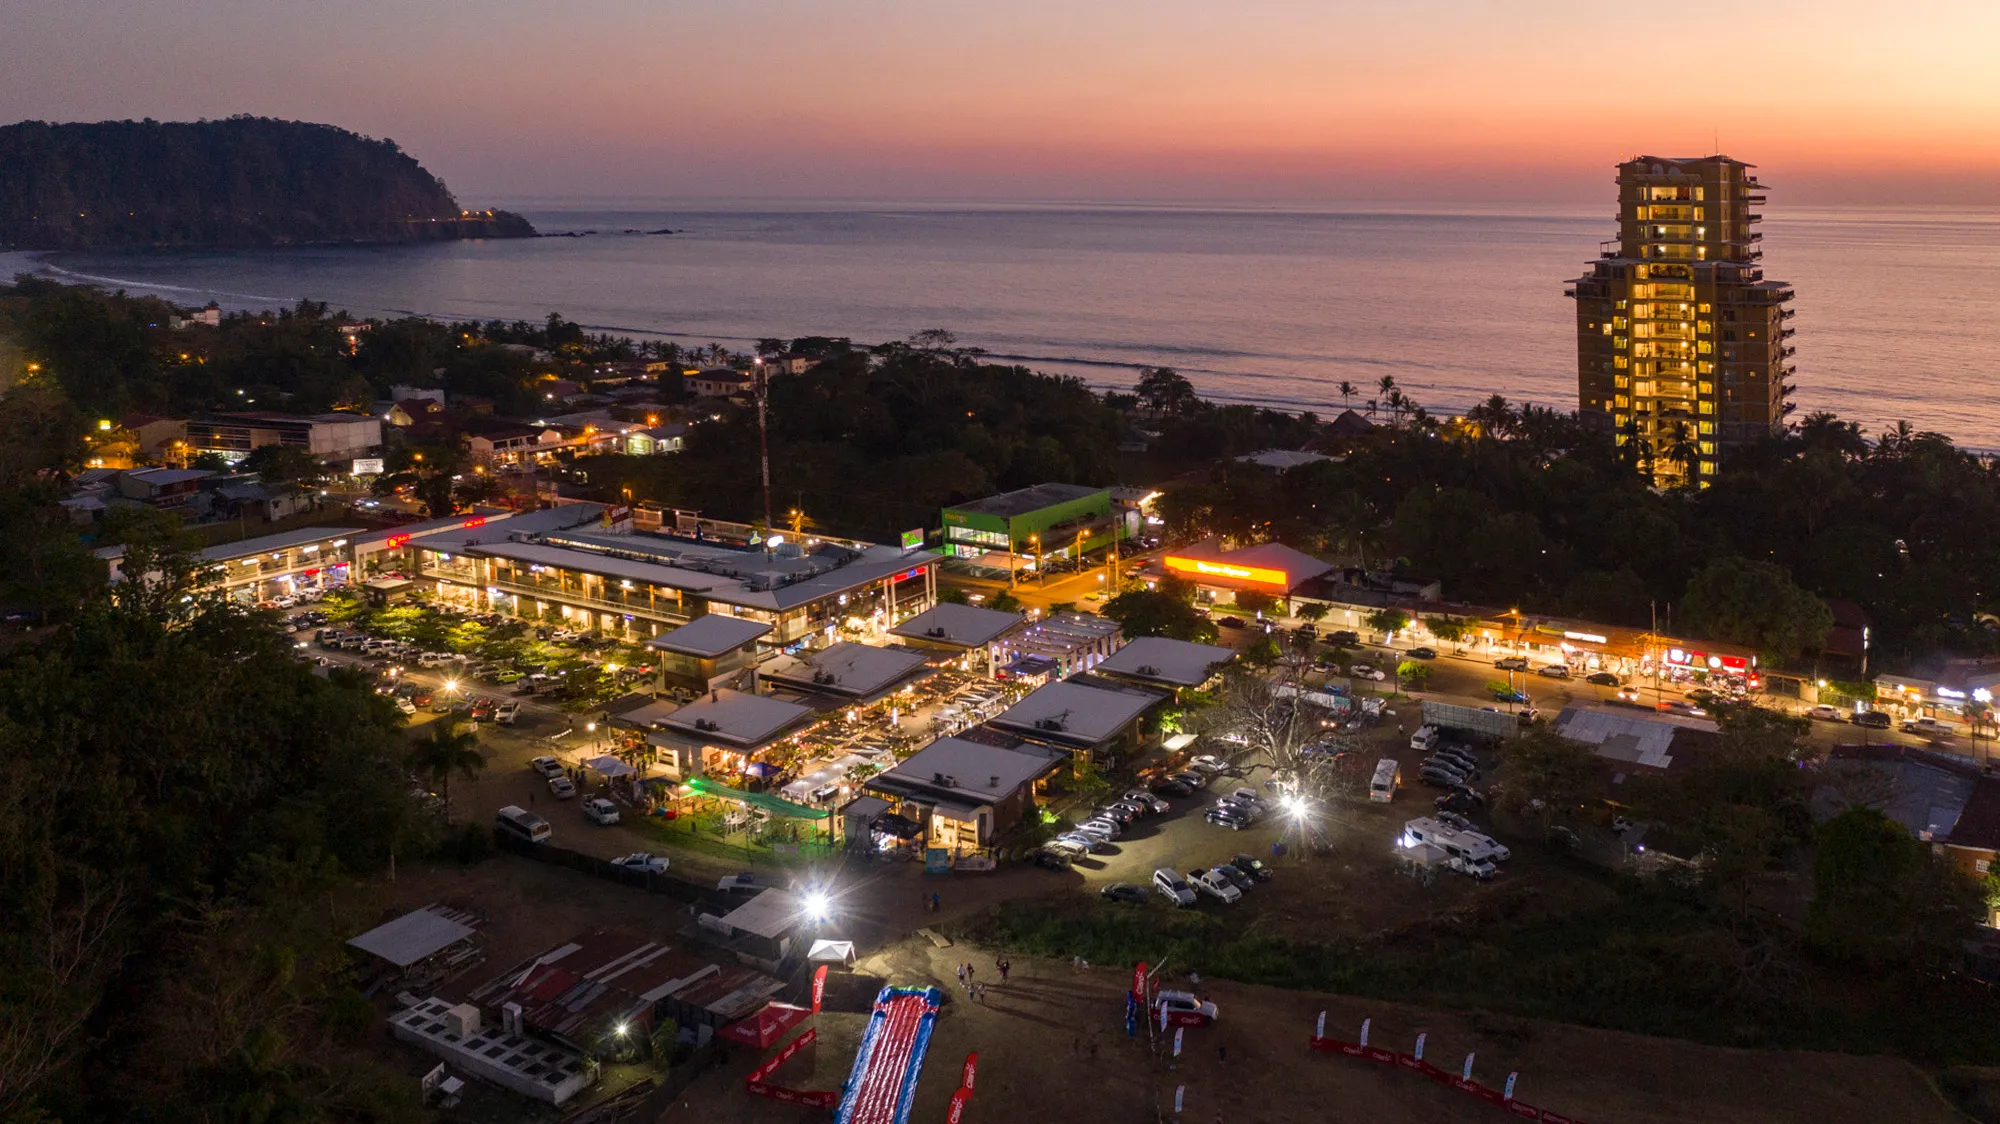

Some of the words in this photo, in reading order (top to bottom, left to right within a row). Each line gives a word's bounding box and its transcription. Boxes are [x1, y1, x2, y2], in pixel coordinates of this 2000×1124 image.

[814, 978, 824, 1004] Claro
[736, 1026, 757, 1037] Claro
[762, 1021, 778, 1036] Claro
[1372, 1051, 1392, 1062] Claro
[766, 1058, 780, 1073] Claro
[1401, 1057, 1421, 1069] Claro
[965, 1064, 976, 1089] Claro
[1455, 1080, 1476, 1092] Claro
[775, 1090, 796, 1101] Claro
[802, 1096, 823, 1107] Claro
[950, 1098, 963, 1124] Claro
